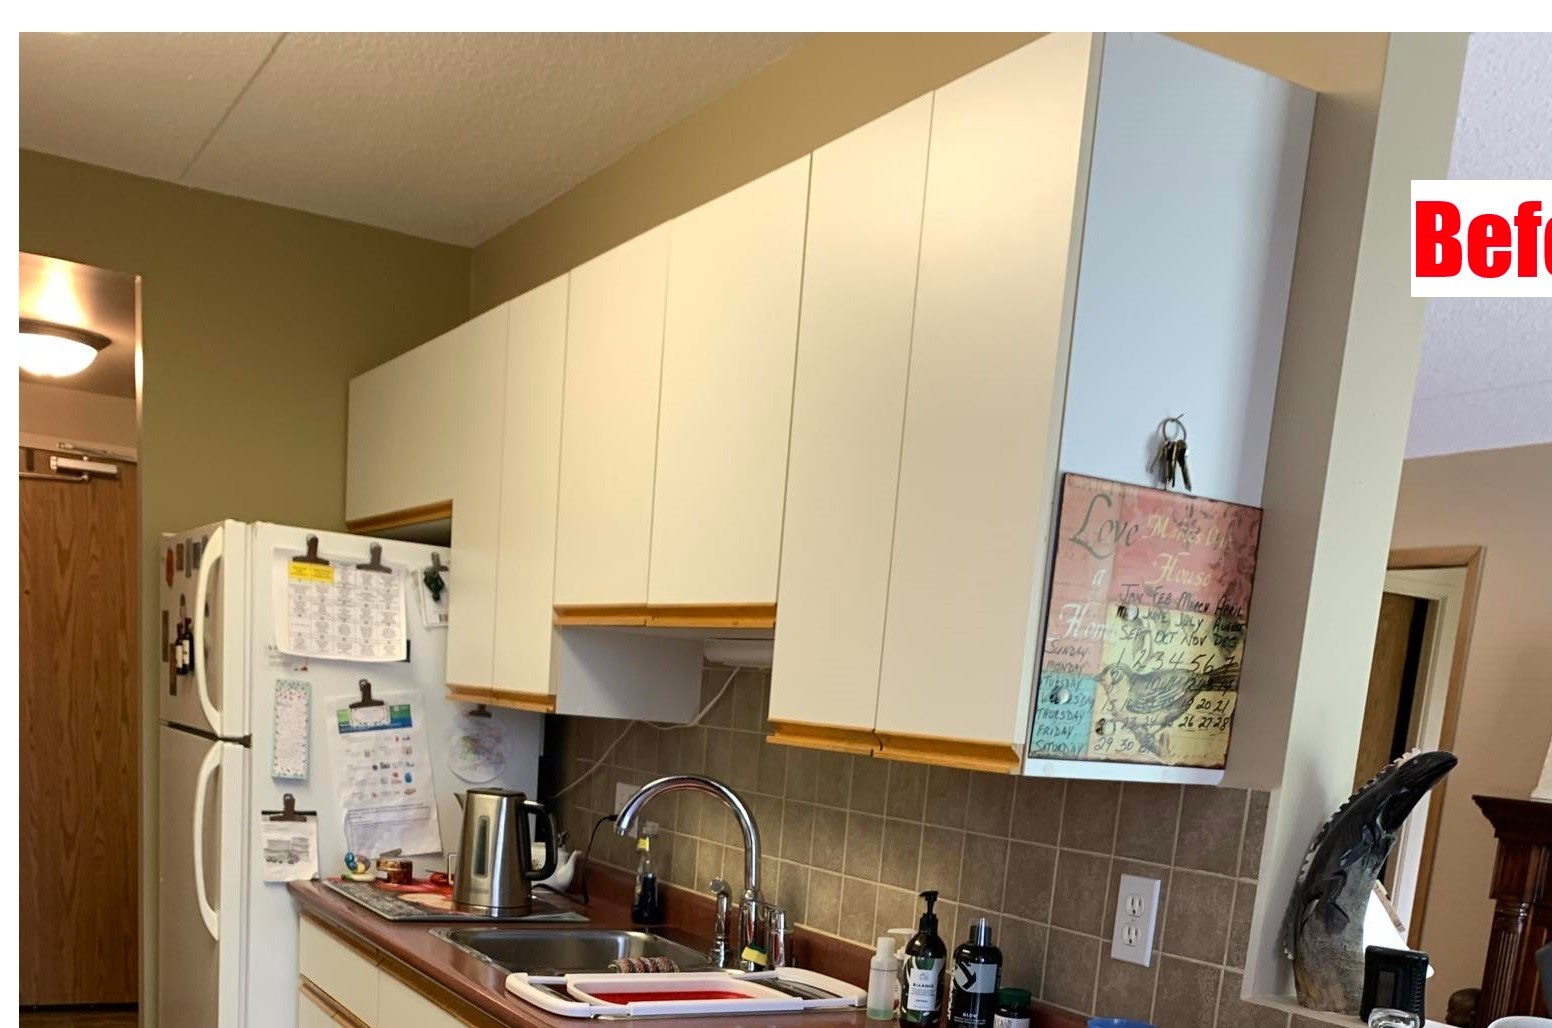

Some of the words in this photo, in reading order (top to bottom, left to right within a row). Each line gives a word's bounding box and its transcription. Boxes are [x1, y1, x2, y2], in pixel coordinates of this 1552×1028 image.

[1068, 492, 1138, 560] Love
[1091, 568, 1107, 587] a
[1143, 551, 1212, 587] House
[1046, 601, 1115, 641] Hom
[1175, 611, 1204, 634] JULY
[1119, 623, 1151, 641] SEPT
[1153, 630, 1178, 645] OCT
[1179, 632, 1208, 647] NOV
[1045, 639, 1090, 658] SUNDAY
[1168, 651, 1185, 673] 4
[1190, 654, 1207, 673] 5
[1203, 654, 1215, 675] 6
[1043, 674, 1082, 691] TUESDAY
[1196, 697, 1212, 710] 20
[1037, 706, 1086, 724] THURSDAY
[1178, 716, 1195, 728] 26
[1213, 717, 1230, 731] 28
[1037, 724, 1075, 740] FRIDAY
[1035, 739, 1086, 755] SATURDAY
[1094, 736, 1114, 752] 29
